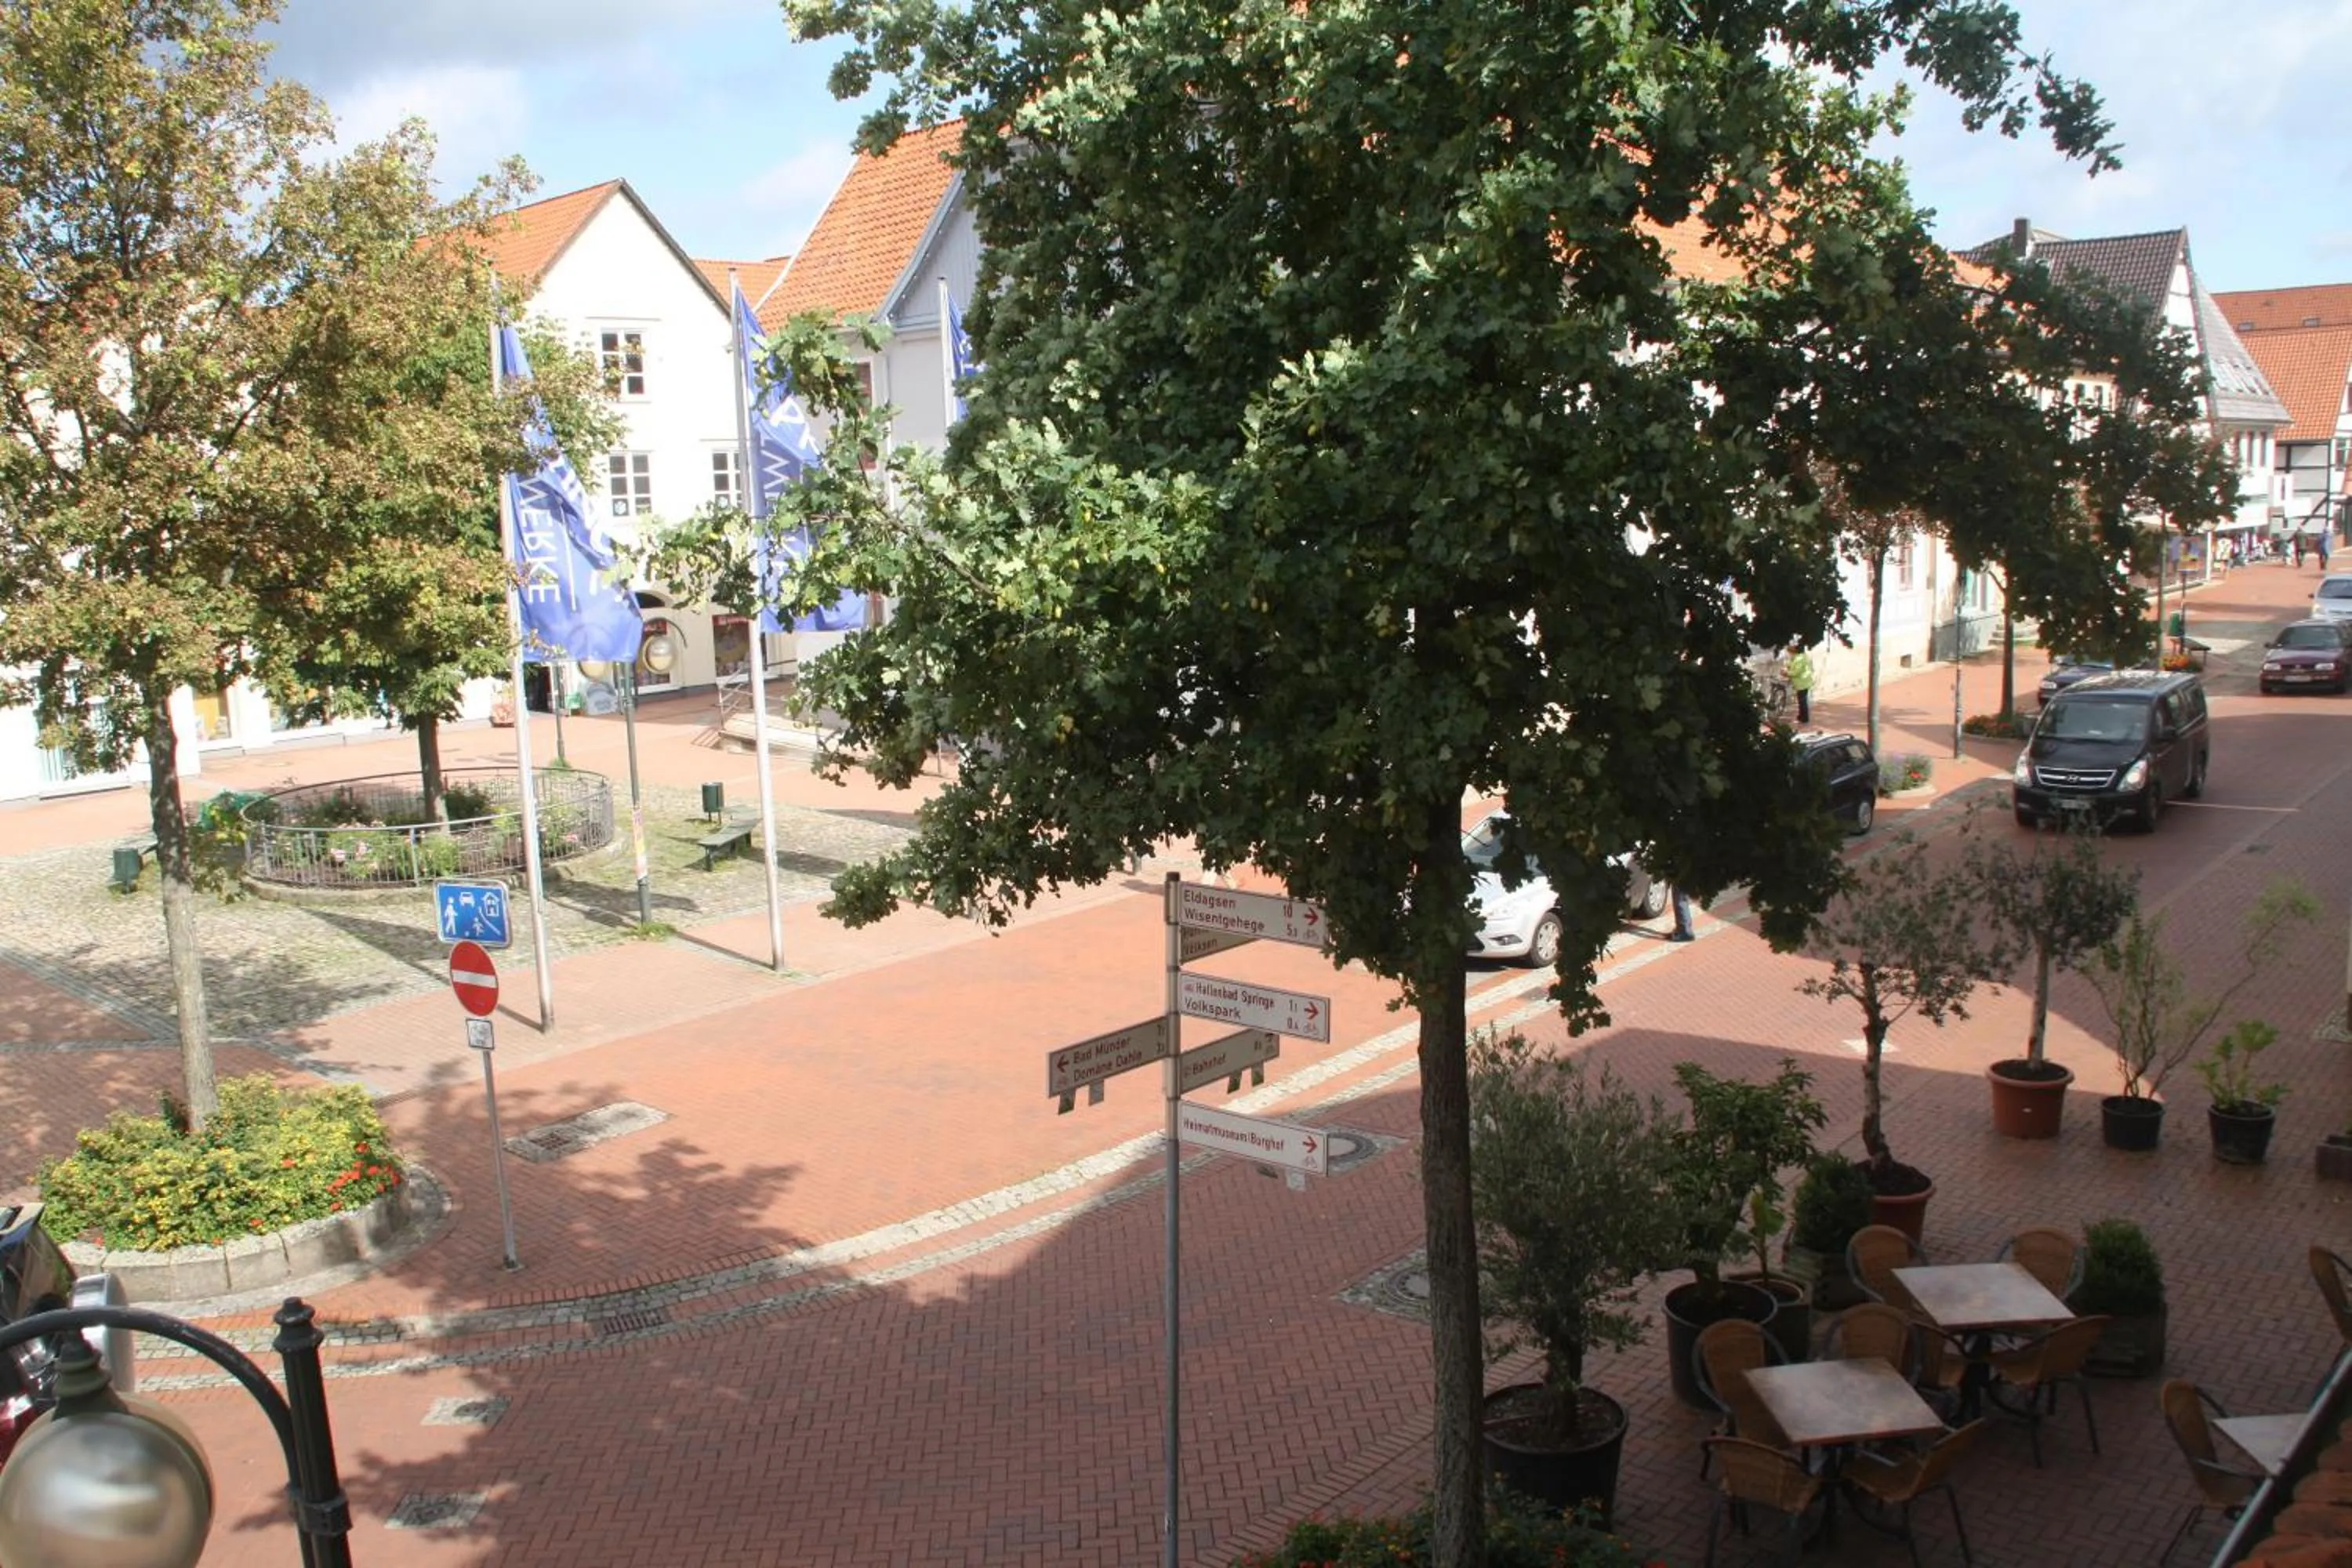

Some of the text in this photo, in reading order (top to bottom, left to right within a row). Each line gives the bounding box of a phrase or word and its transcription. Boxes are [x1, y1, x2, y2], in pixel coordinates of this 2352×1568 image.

[1183, 889, 1236, 909] Eldagsen
[1185, 907, 1265, 934] Wisentgehege
[1185, 996, 1242, 1019] Volkspark
[1196, 982, 1238, 1002] Hallenbad
[1241, 989, 1276, 1011] Springe
[1073, 1036, 1131, 1065] Bad Münder
[1192, 1052, 1226, 1075] Bahnhof
